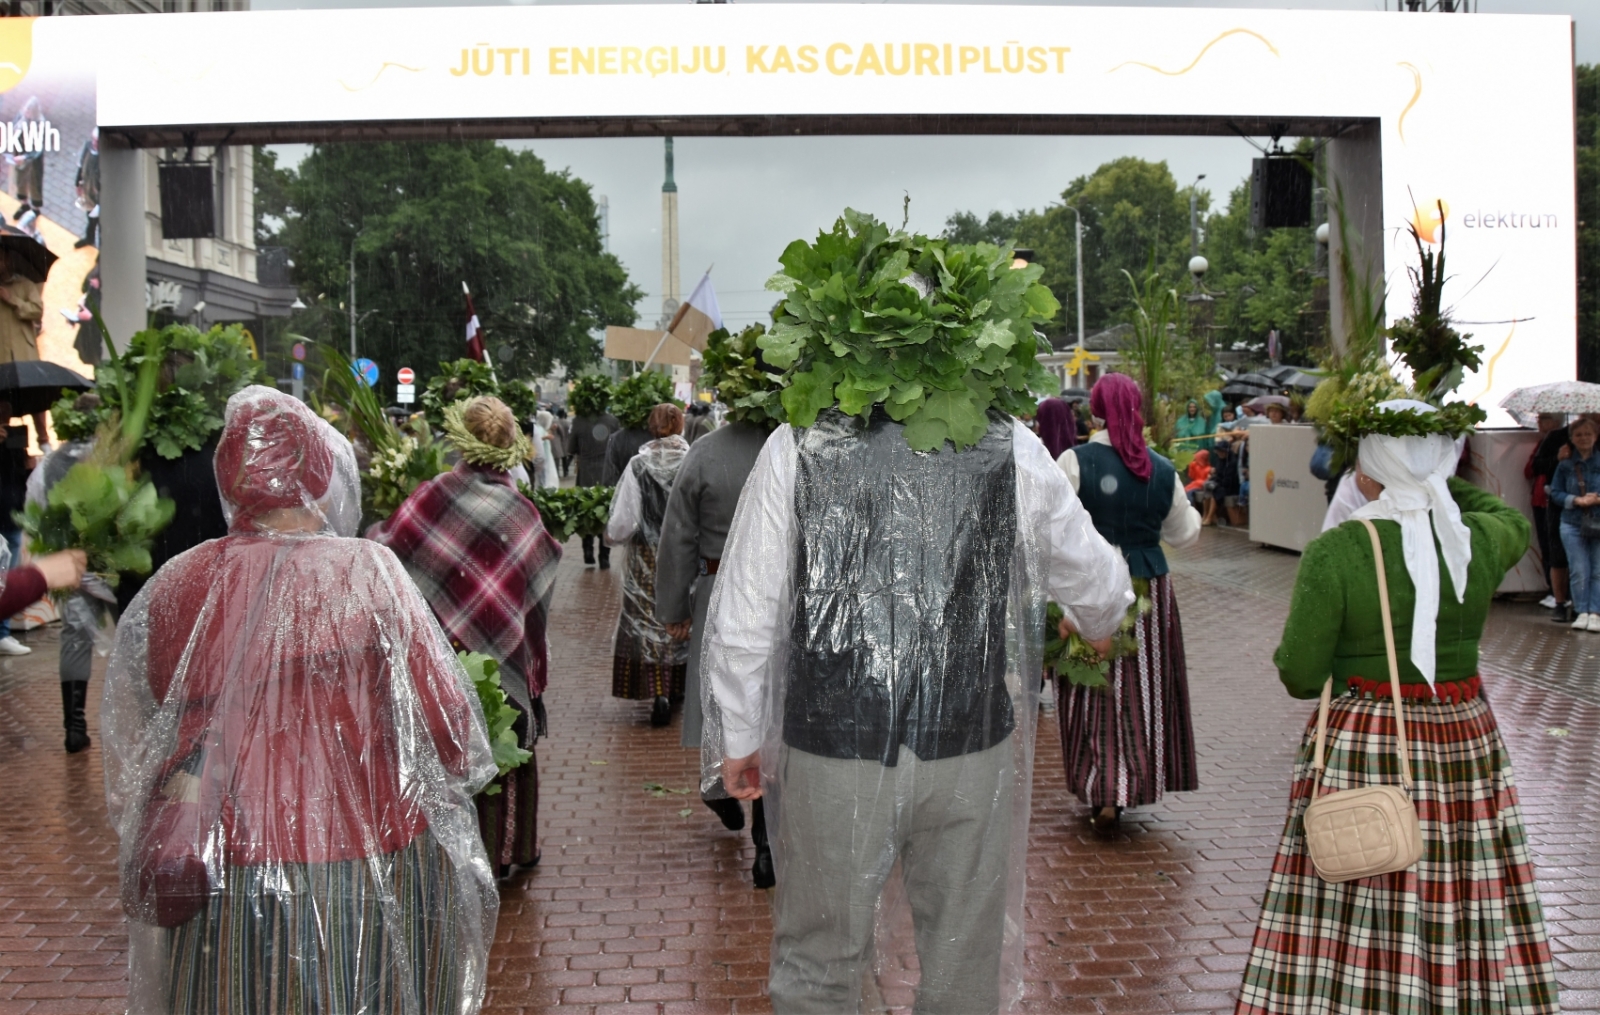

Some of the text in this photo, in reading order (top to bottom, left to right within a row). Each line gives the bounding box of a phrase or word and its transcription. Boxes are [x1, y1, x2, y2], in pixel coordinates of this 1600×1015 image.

[449, 42, 531, 77] JŪTI
[745, 44, 820, 74] KAS
[824, 41, 954, 77] CAURI
[958, 40, 1072, 74] PLŪST
